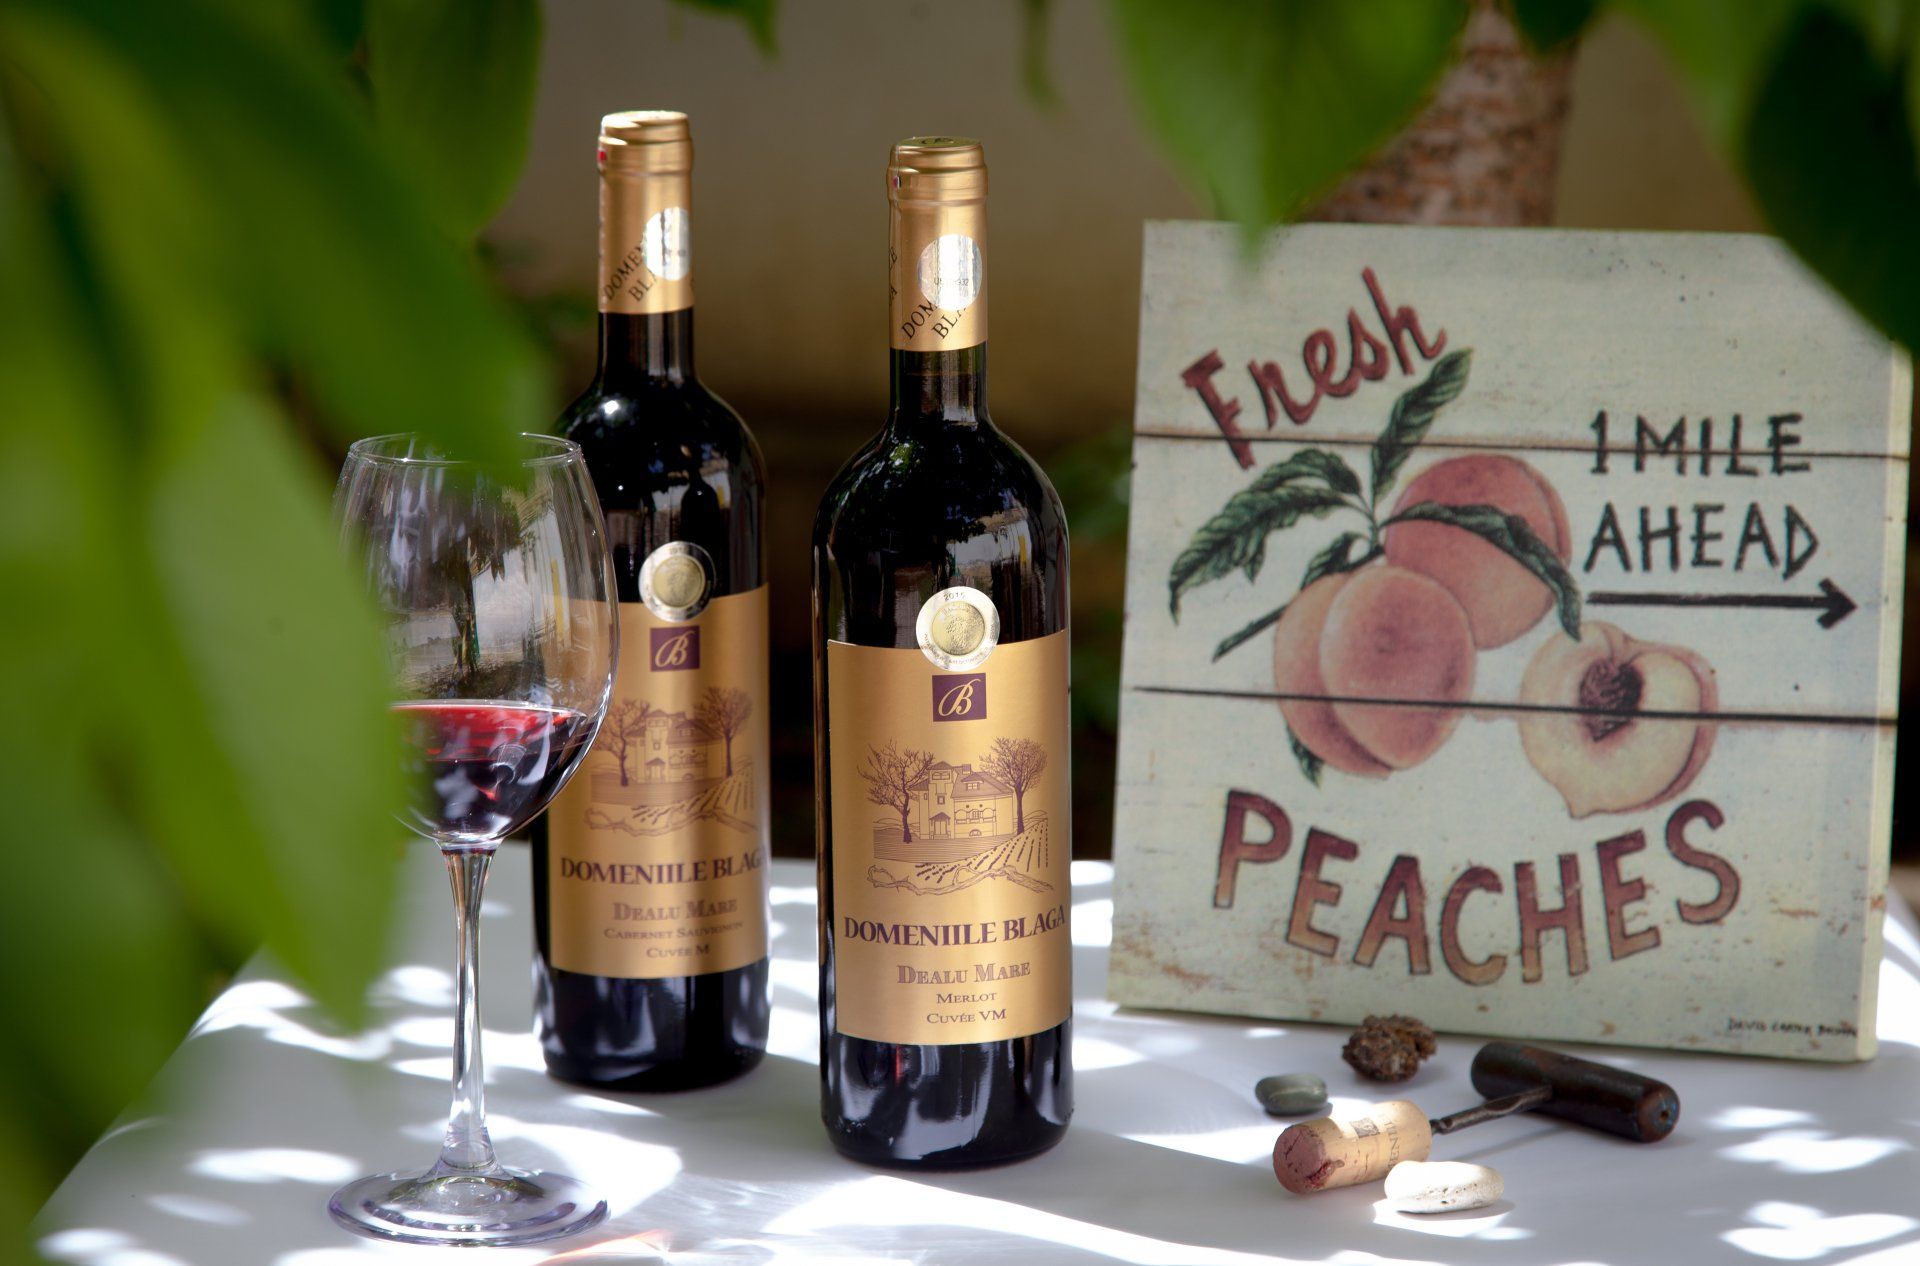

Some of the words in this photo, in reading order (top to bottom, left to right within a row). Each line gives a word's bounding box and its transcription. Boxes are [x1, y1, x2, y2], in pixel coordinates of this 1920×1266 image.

[1181, 266, 1448, 471] Fresh
[1590, 410, 1608, 474] 1
[1635, 413, 1811, 477] MILE
[1583, 502, 1819, 580] AHEAD
[560, 857, 707, 885] DOMENIILE
[1213, 789, 1741, 987] PEACHES
[844, 916, 997, 946] DOMENIILE
[1003, 904, 1066, 941] BLAGA
[979, 1009, 1007, 1021] VM
